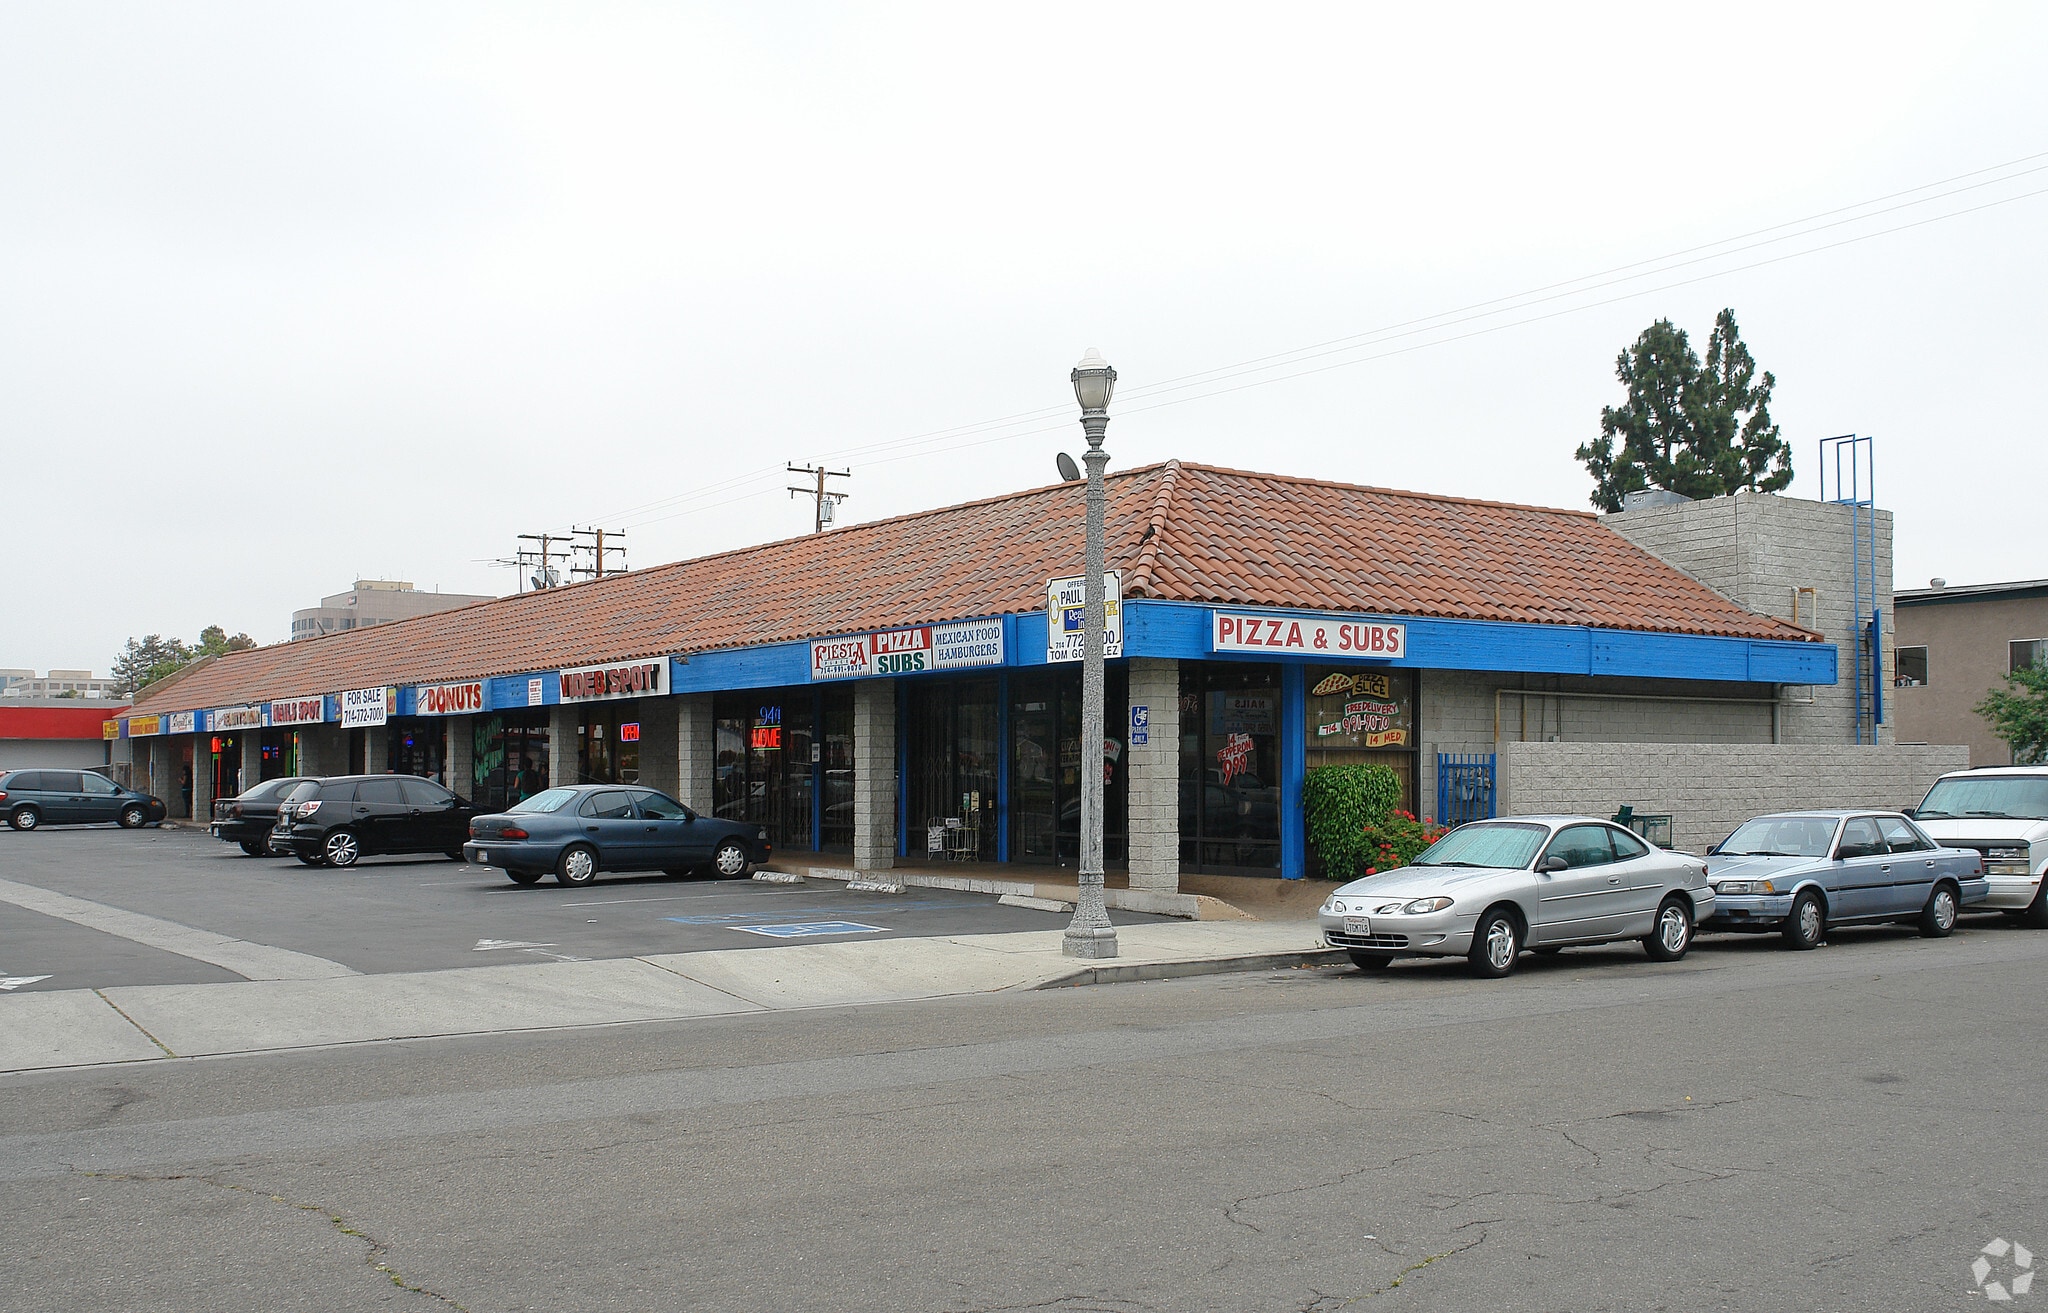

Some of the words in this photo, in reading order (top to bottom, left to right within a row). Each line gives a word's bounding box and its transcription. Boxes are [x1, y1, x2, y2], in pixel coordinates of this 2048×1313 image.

[1060, 589, 1082, 605] PAUL
[876, 629, 925, 653] PIZZA
[935, 631, 974, 646] MEXICAN
[976, 626, 1000, 641] FOOD
[1219, 617, 1304, 648] PIZZA
[1313, 628, 1328, 649] &
[1339, 624, 1399, 652] SUBS
[814, 641, 868, 669] FIESTA
[938, 643, 998, 661] HAMBURGERS
[1050, 649, 1067, 660] TOM
[878, 652, 925, 674] SUBS
[560, 670, 606, 698] VIDEO
[608, 664, 656, 694] SPOT
[1355, 682, 1386, 695] SLICE
[1358, 674, 1384, 684] PIZZA
[347, 691, 362, 706] FOR
[362, 688, 381, 703] SALE
[427, 684, 482, 713] DONUTS
[273, 702, 297, 722] NAILS
[299, 700, 321, 721] SPOT
[344, 707, 384, 724] 714-772-7000
[1346, 702, 1361, 713] FREE
[1362, 701, 1397, 714] DELIVERY
[623, 725, 639, 740] OPEN
[1322, 724, 1337, 734] 714
[1342, 714, 1389, 735] 991-9070
[1369, 735, 1378, 745] 14
[1384, 732, 1402, 742] MED.
[1217, 738, 1255, 763] PEPPERONI
[1223, 754, 1248, 786] 999
